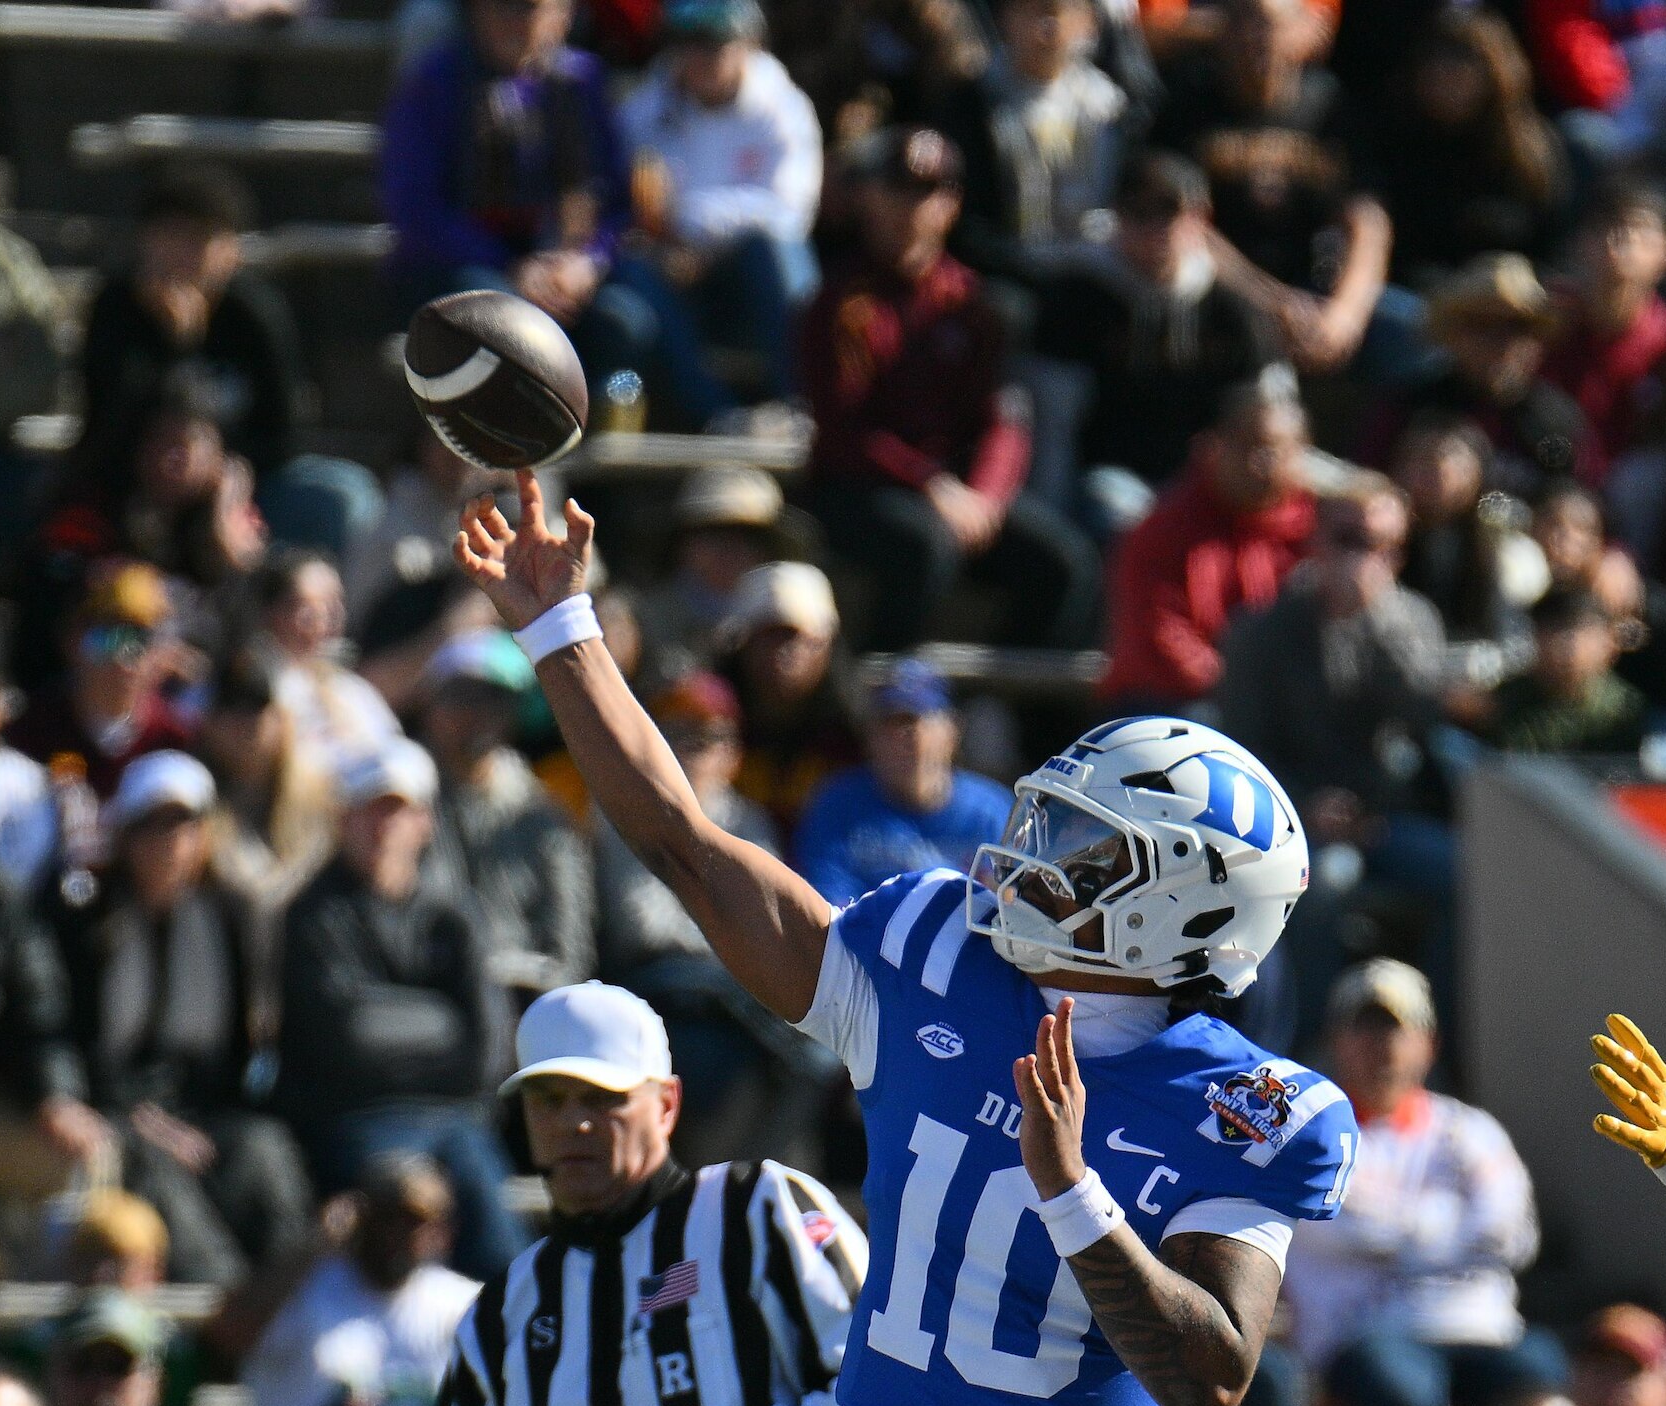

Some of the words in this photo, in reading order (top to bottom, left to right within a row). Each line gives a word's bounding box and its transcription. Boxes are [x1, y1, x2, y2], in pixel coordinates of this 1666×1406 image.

[925, 1028, 963, 1052] ACC
[975, 1090, 1024, 1140] DU
[1205, 1082, 1241, 1110] TONY
[1251, 1115, 1284, 1150] TIGER
[1216, 1104, 1235, 1119] SUN
[1135, 1165, 1181, 1216] C
[867, 1112, 1094, 1399] 10
[532, 1315, 557, 1349] S
[655, 1351, 695, 1399] R
